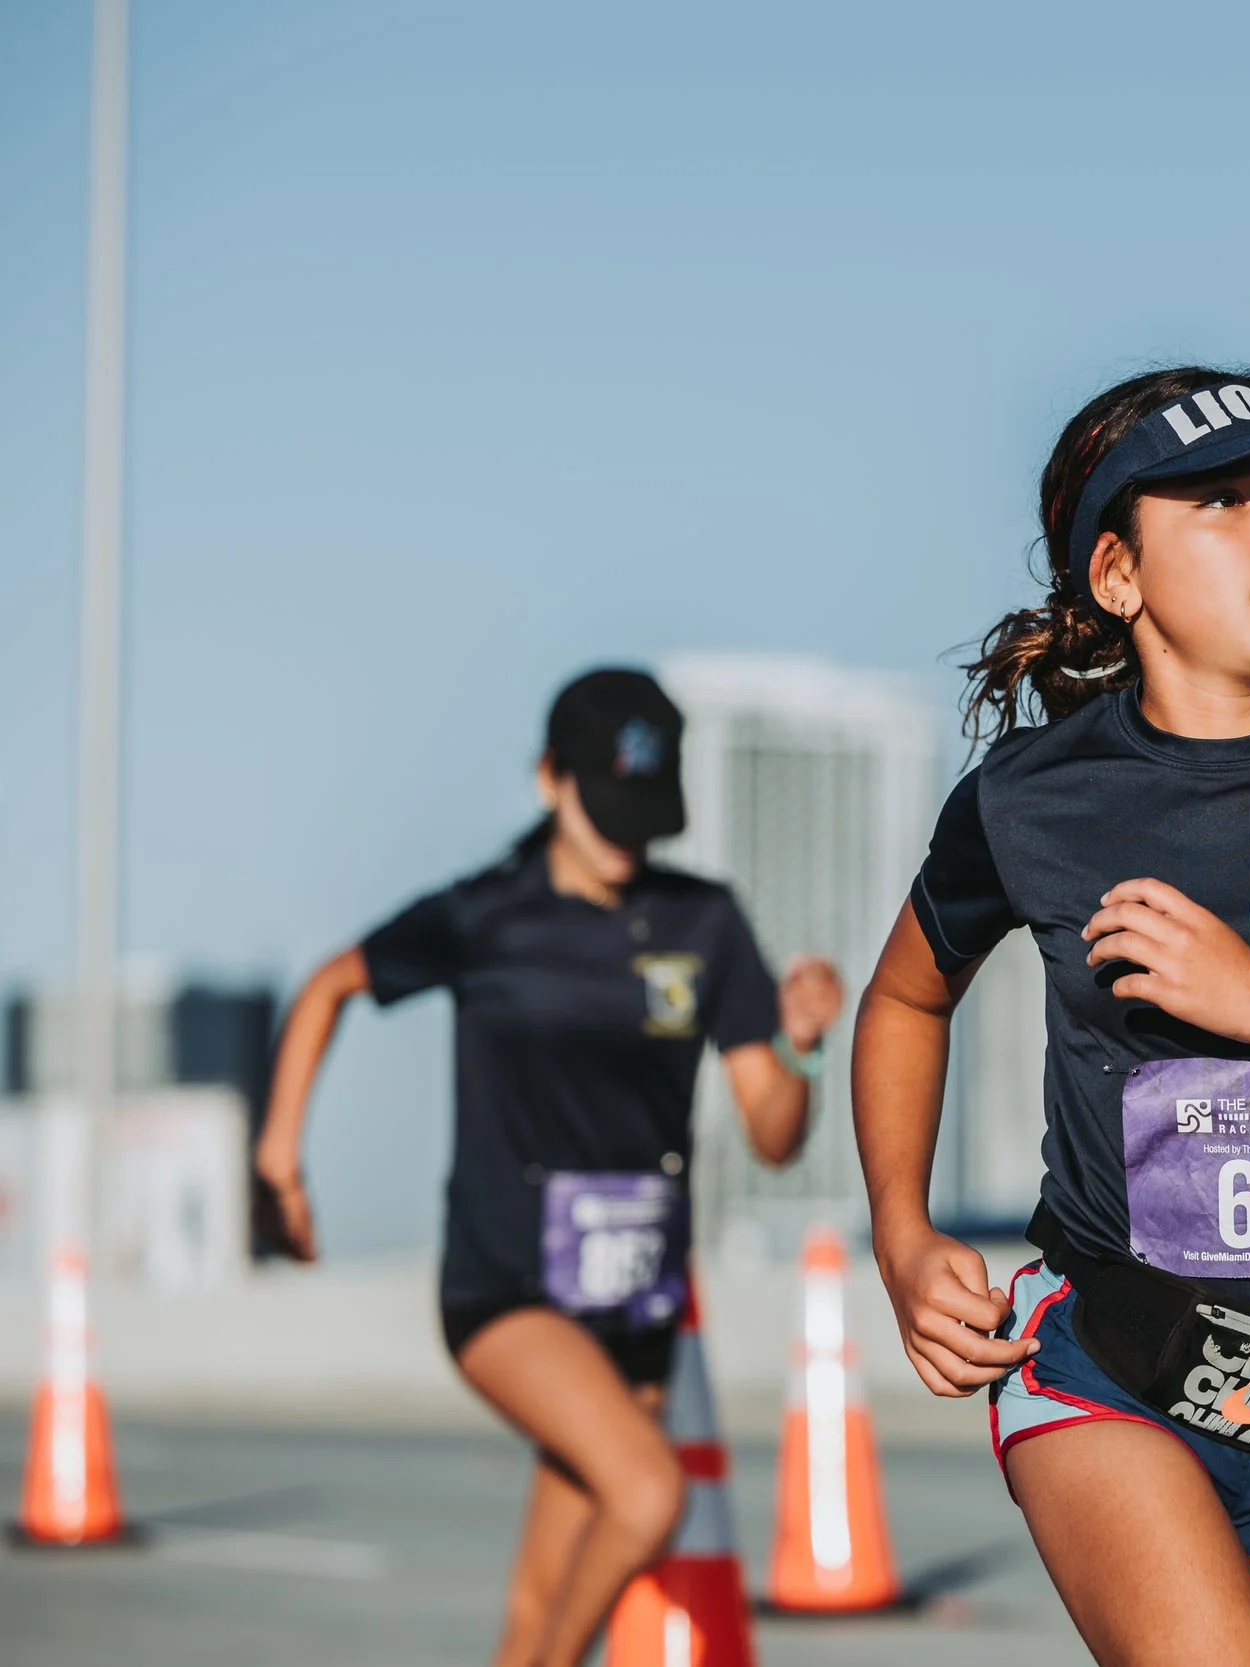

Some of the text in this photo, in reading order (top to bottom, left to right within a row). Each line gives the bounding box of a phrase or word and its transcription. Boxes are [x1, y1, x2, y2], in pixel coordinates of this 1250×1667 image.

[1217, 1098, 1246, 1111] THE
[1203, 1144, 1230, 1154] Hosted
[1231, 1144, 1241, 1155] by
[1183, 1250, 1200, 1261] Visit
